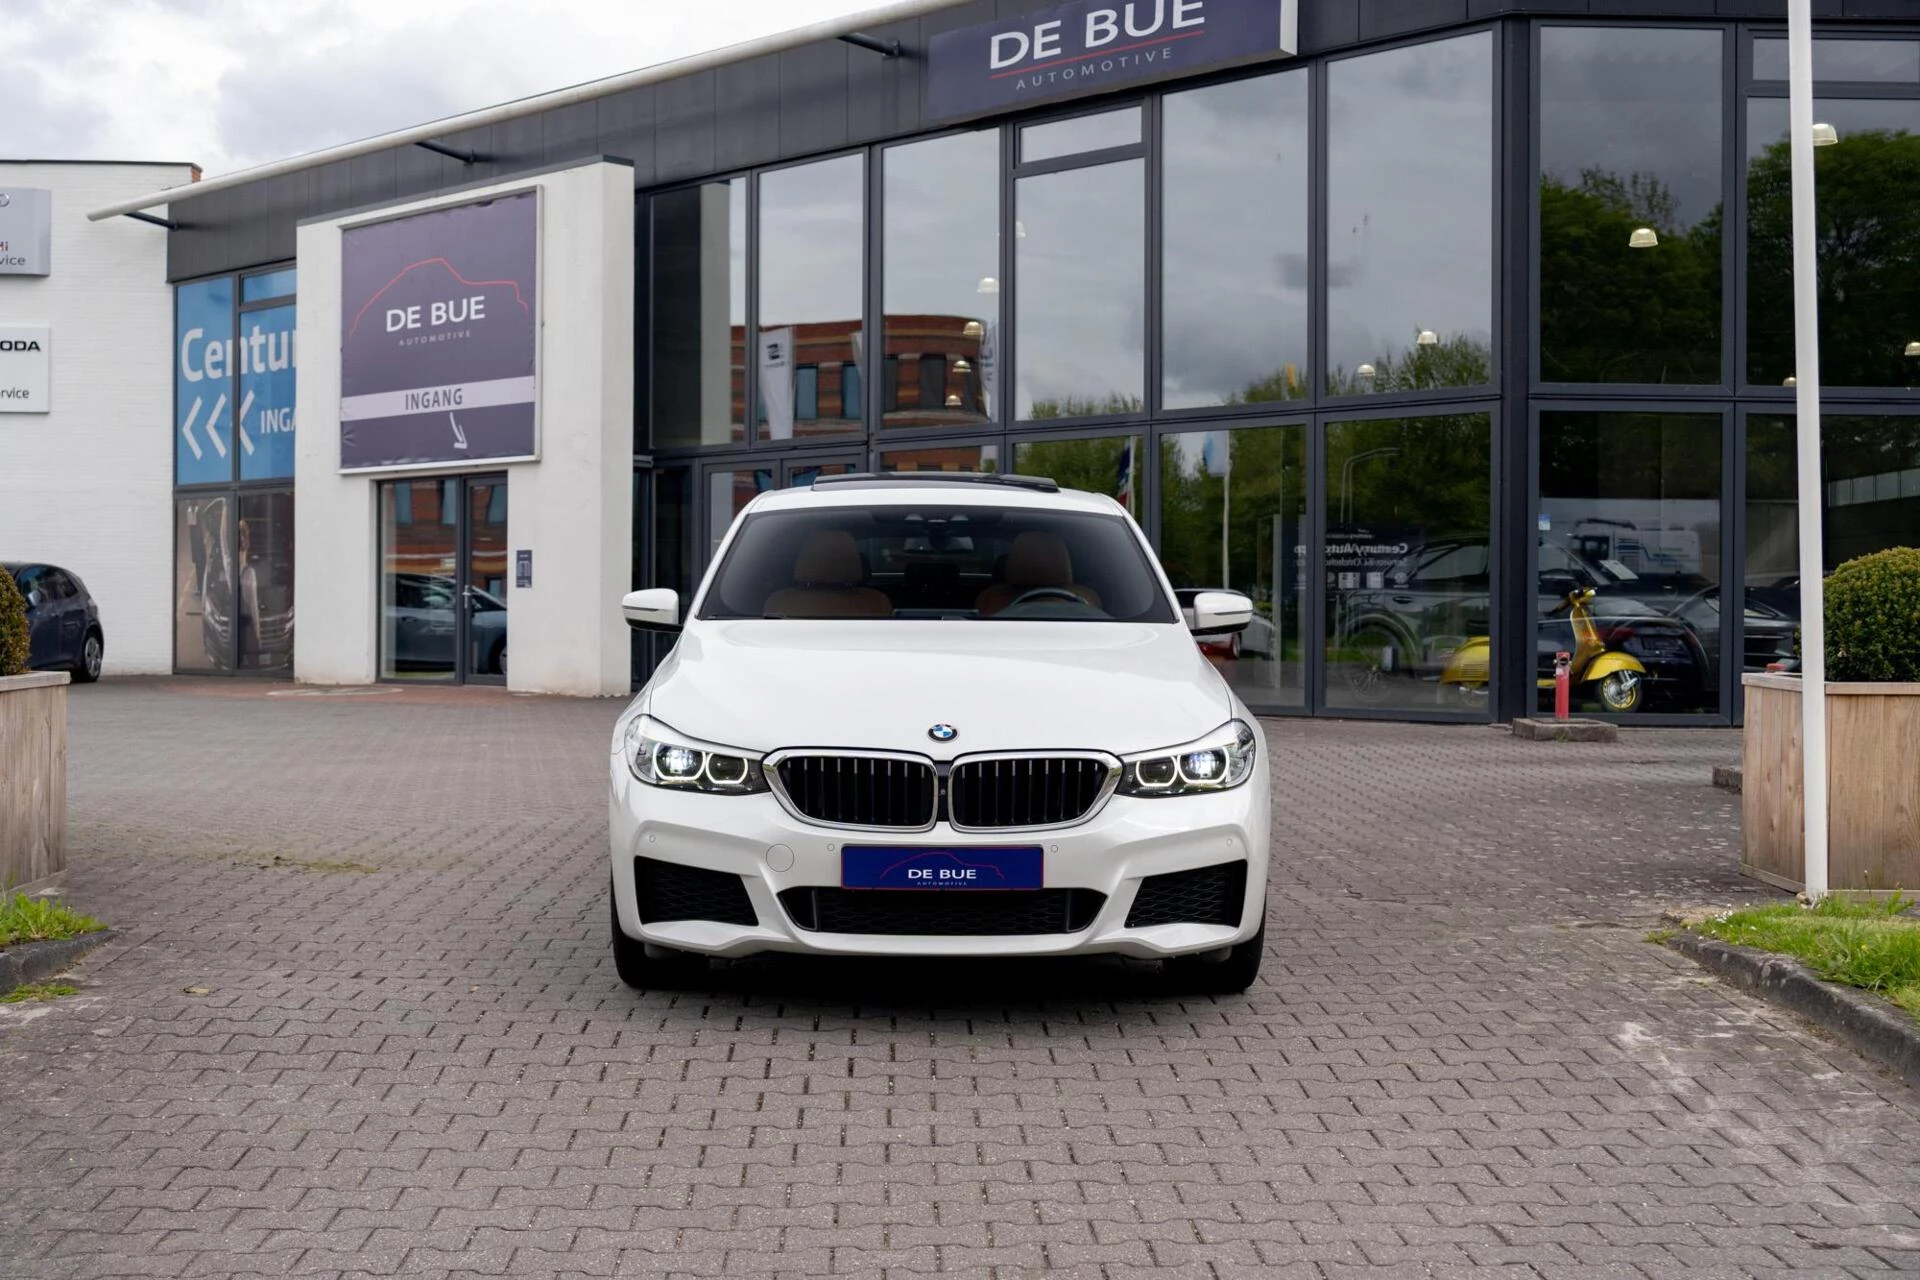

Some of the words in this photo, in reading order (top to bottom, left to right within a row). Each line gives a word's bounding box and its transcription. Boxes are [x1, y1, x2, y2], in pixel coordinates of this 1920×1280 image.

[990, 20, 1062, 69] DE
[1085, 0, 1205, 48] BUE
[1015, 48, 1172, 90] AUTOMOTIVE
[386, 306, 421, 332] DE
[431, 296, 485, 326] BUE
[398, 330, 471, 346] AUTOMOTIVE
[405, 388, 463, 411] INGANG
[908, 869, 933, 879] DE
[939, 869, 977, 879] BUE
